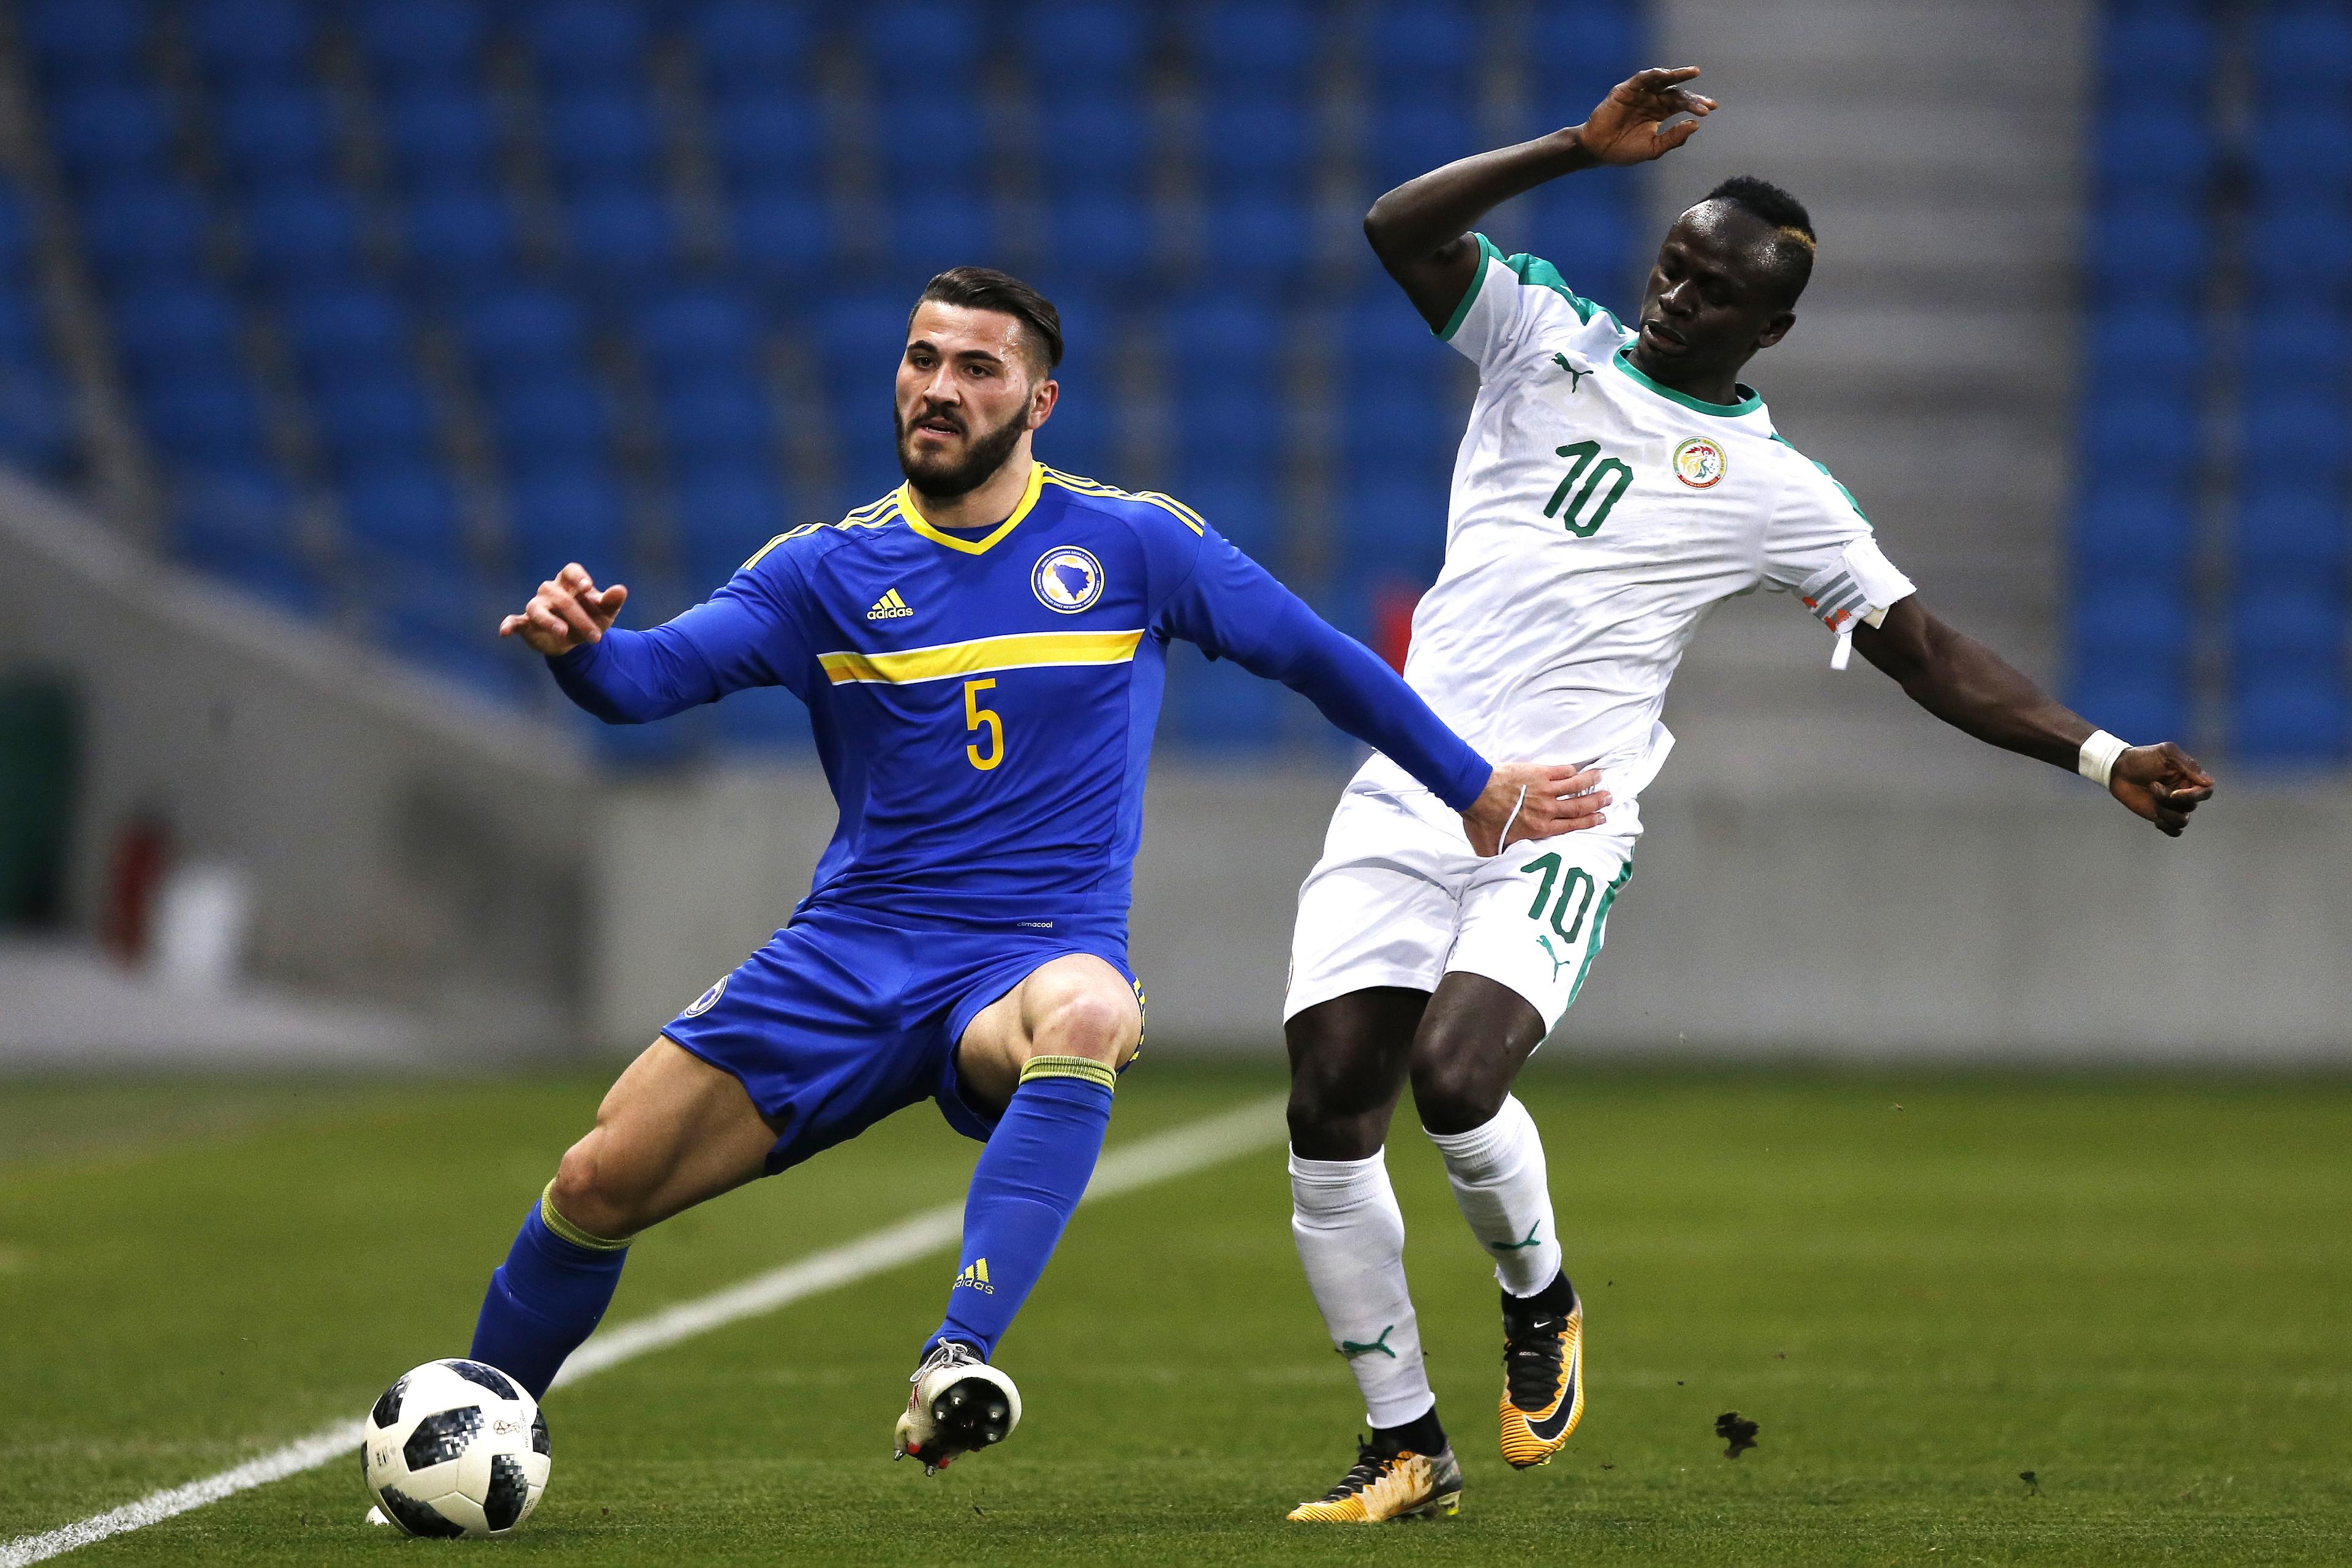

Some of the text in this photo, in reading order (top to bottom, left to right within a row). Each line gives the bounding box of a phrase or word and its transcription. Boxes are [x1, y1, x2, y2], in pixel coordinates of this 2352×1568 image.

[1543, 440, 1634, 538] 10
[867, 607, 914, 620] adidas
[964, 677, 1004, 771] 5
[1520, 852, 1595, 943] 10
